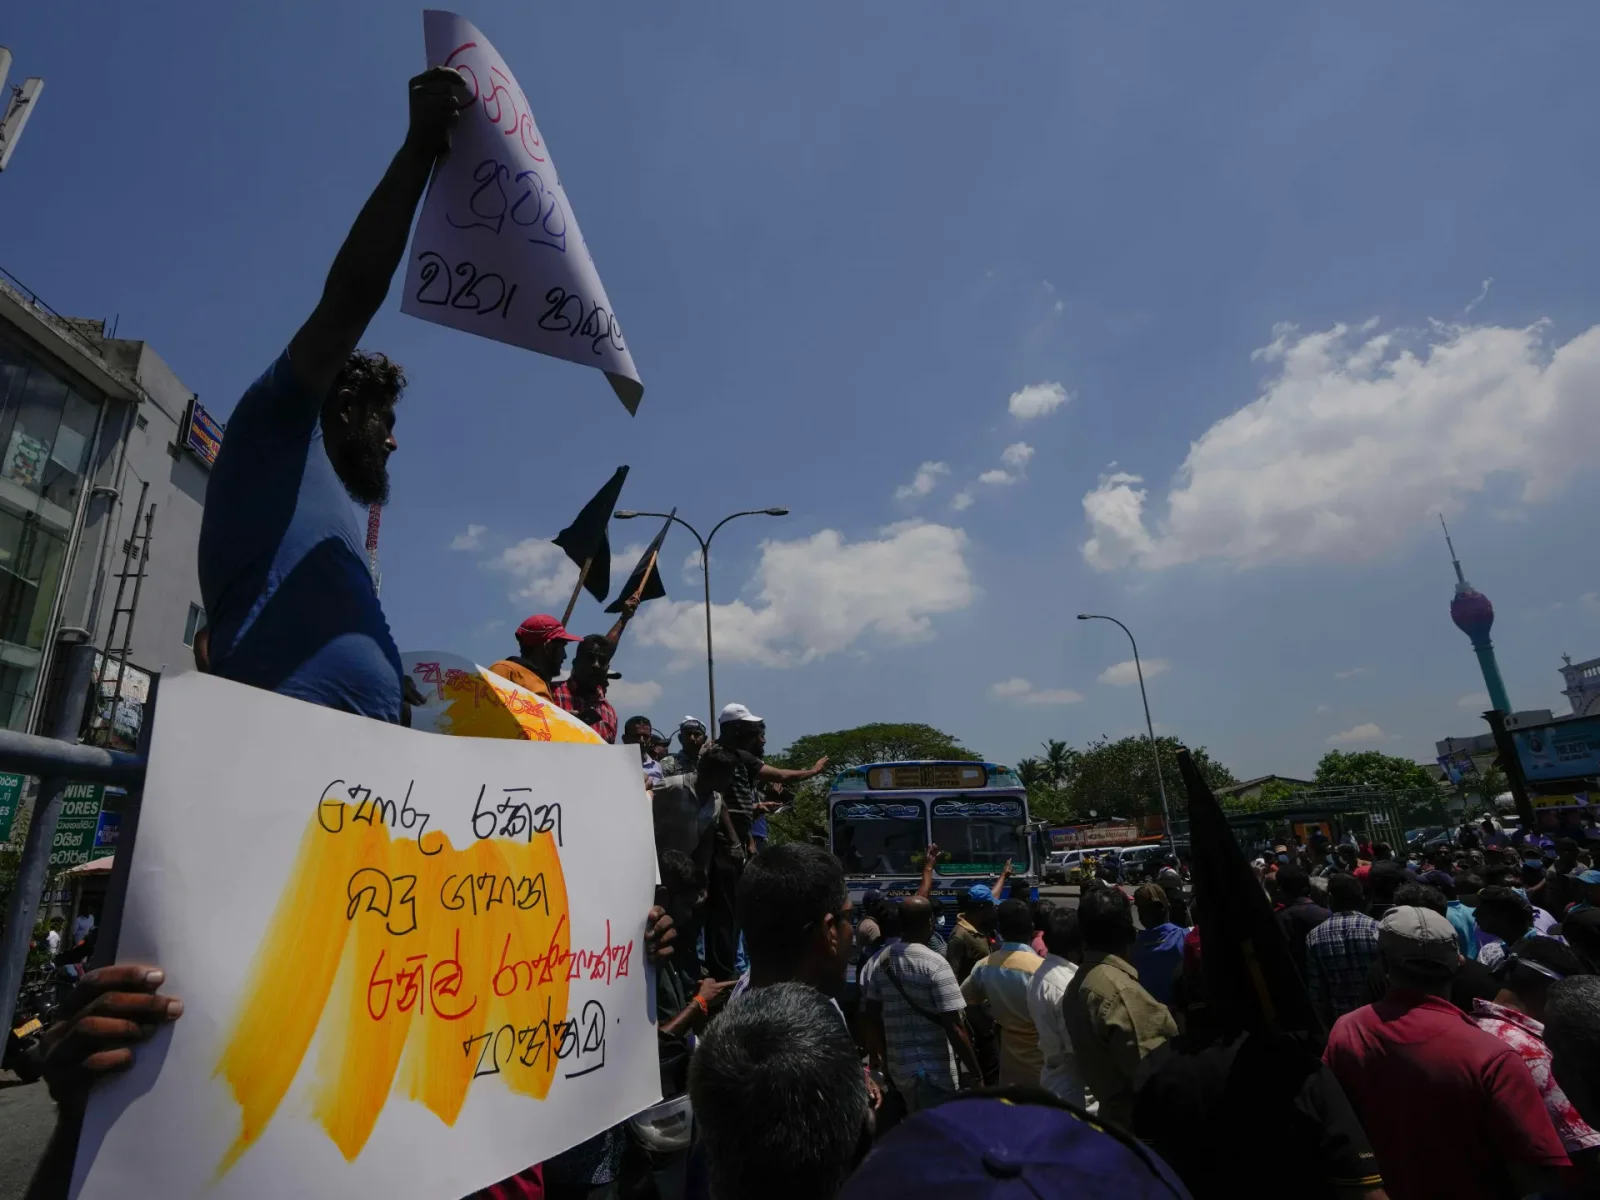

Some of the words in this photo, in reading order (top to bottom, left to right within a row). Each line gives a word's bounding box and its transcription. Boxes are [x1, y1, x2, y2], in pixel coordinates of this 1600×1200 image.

[64, 784, 96, 799] WINE
[59, 800, 99, 815] TORES
[317, 778, 444, 856] හොරු
[53, 832, 84, 847] වයින්
[49, 849, 90, 865] ටෝර්ස්
[346, 867, 418, 936] බදු
[440, 871, 551, 916] ගහන
[367, 928, 478, 1021] රනිල්
